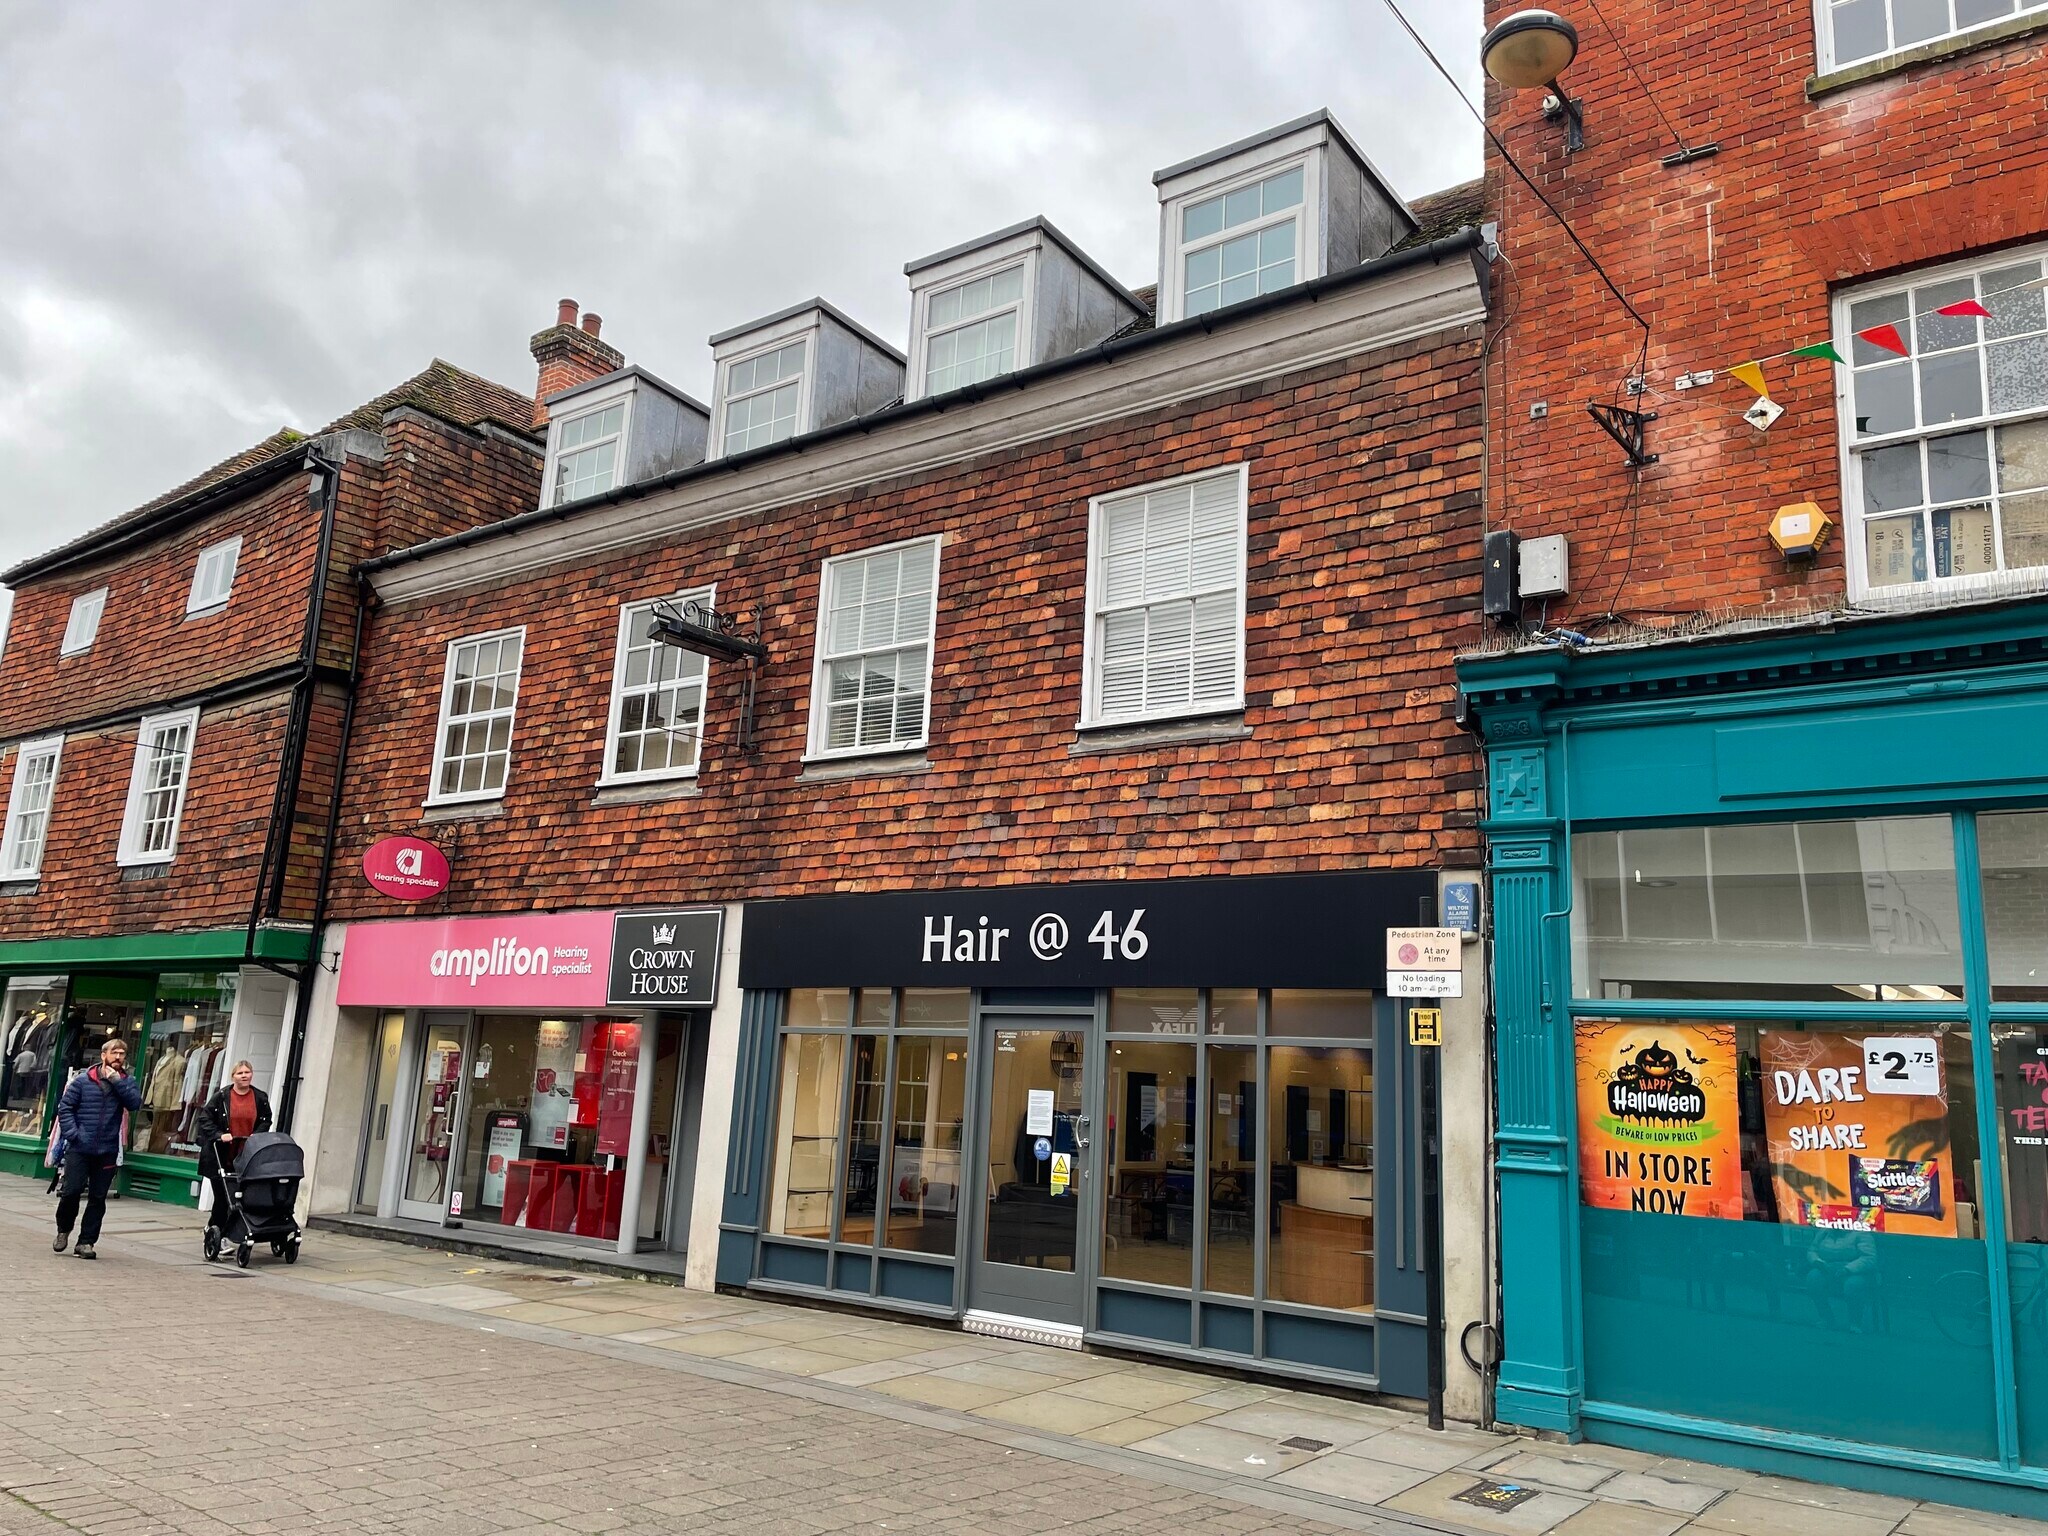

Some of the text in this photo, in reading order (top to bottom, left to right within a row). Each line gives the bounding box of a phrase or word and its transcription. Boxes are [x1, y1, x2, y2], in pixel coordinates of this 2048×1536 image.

[1875, 531, 1885, 540] 18
[1983, 525, 1992, 565] 400014171
[1493, 559, 1500, 569] 4
[374, 872, 440, 888] Hearing specialist
[922, 909, 1149, 963] Hair @ 46
[430, 936, 549, 987] amplifon
[553, 946, 588, 961] Hearing
[629, 948, 695, 970] CROWN
[1428, 955, 1446, 963] time
[552, 961, 592, 977] specialist
[630, 973, 688, 995] HOUSE
[1415, 975, 1446, 983] loading
[612, 1050, 627, 1058] Check
[1639, 1078, 1673, 1091] HAPPY
[1774, 1066, 1864, 1106] DARE
[1613, 1085, 1700, 1113] Halloween
[1813, 1106, 1834, 1124] TO
[1616, 1126, 1644, 1140] BEWARE
[1654, 1132, 1670, 1141] LOW
[1672, 1131, 1698, 1142] PRICES
[1788, 1124, 1867, 1151] SHARE
[2014, 1137, 2042, 1145] THIS
[1605, 1150, 1712, 1186] IN STORE
[1868, 1172, 1925, 1189] Skittles
[1631, 1187, 1686, 1215] NOW
[1815, 1217, 1872, 1231] Skittles
